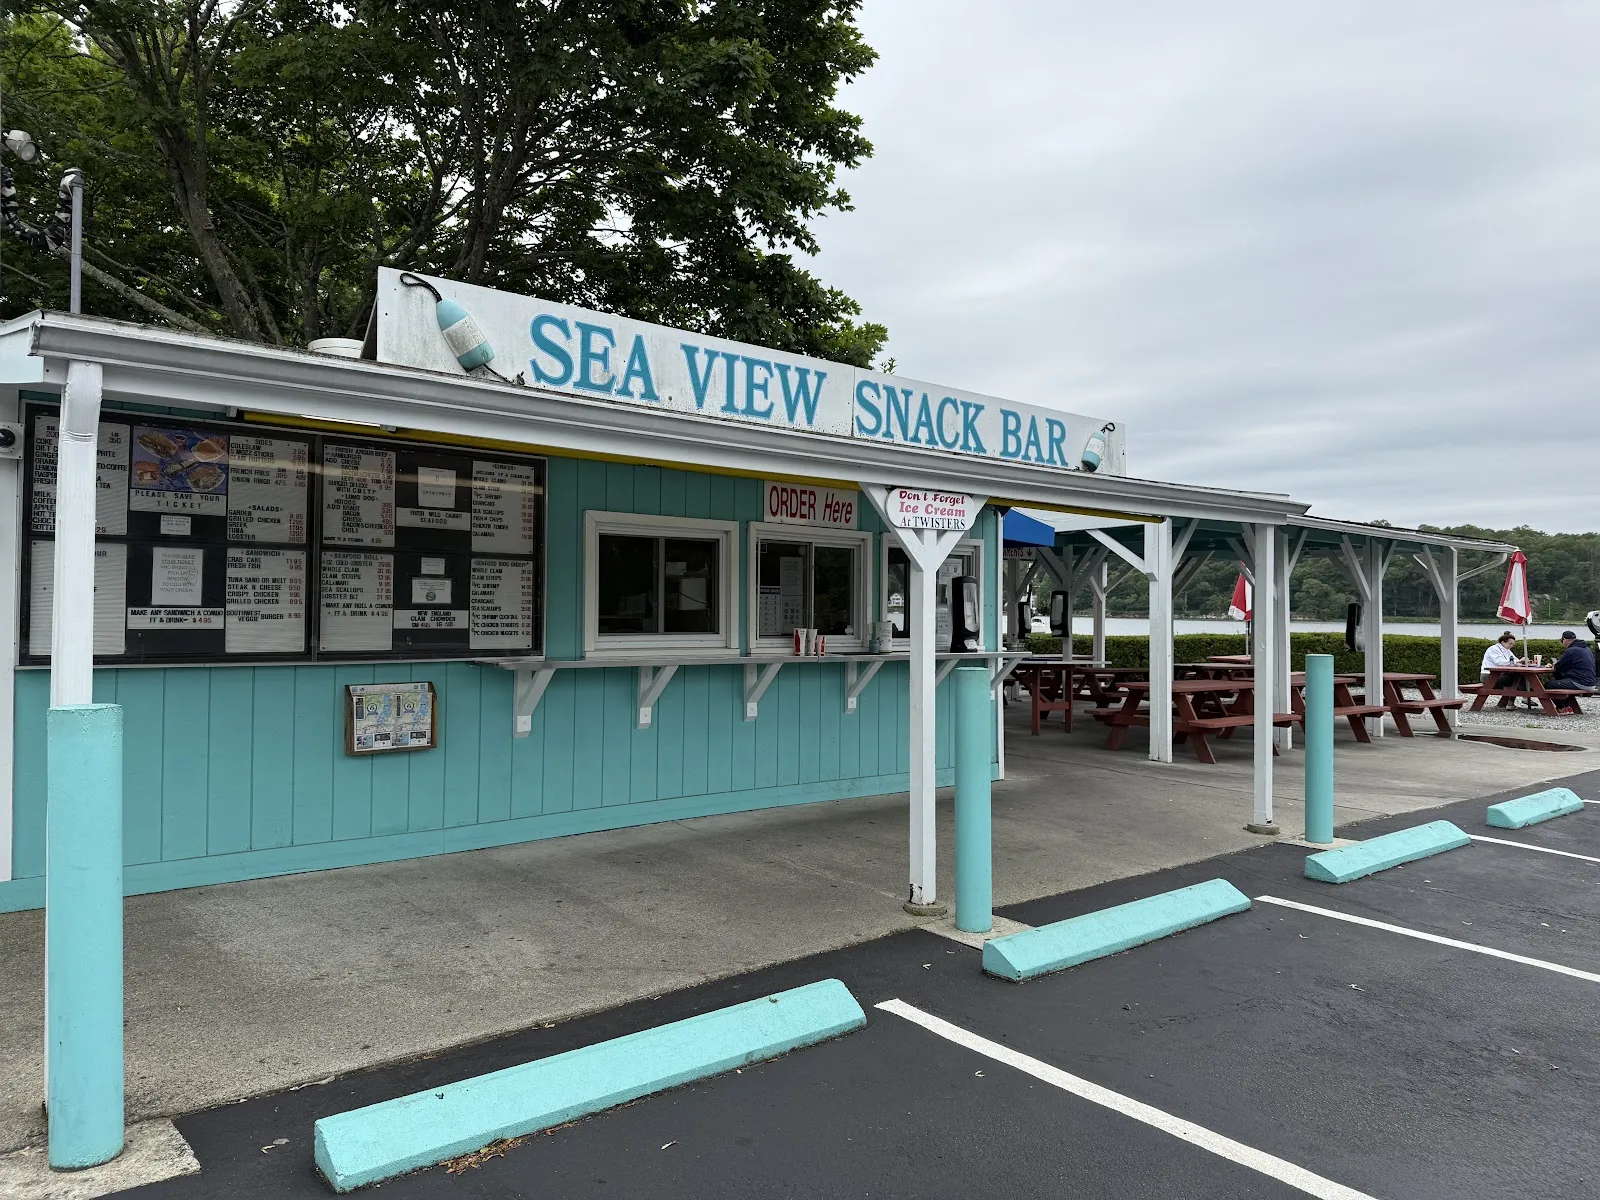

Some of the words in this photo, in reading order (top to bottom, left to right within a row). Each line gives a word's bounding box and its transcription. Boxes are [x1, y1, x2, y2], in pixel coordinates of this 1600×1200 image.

[529, 313, 660, 401] SEA
[679, 343, 828, 425] VIEW
[855, 379, 987, 455] SNACK
[1000, 407, 1069, 467] BAR
[254, 450, 274, 458] STICKS
[34, 490, 50, 498] MILK
[135, 490, 166, 498] PLEASE
[174, 492, 193, 500] SAVE
[200, 494, 220, 502] YOUR
[899, 490, 928, 501] Don't
[932, 494, 966, 506] Forget
[157, 500, 202, 510] TICKET
[770, 486, 816, 520] ORDER
[822, 492, 852, 524] Here
[898, 502, 918, 513] Ice
[924, 504, 966, 517] Cream
[33, 510, 44, 518] HOT
[900, 516, 911, 526] At
[912, 516, 966, 530] TWISTERS
[228, 576, 243, 584] TUNA
